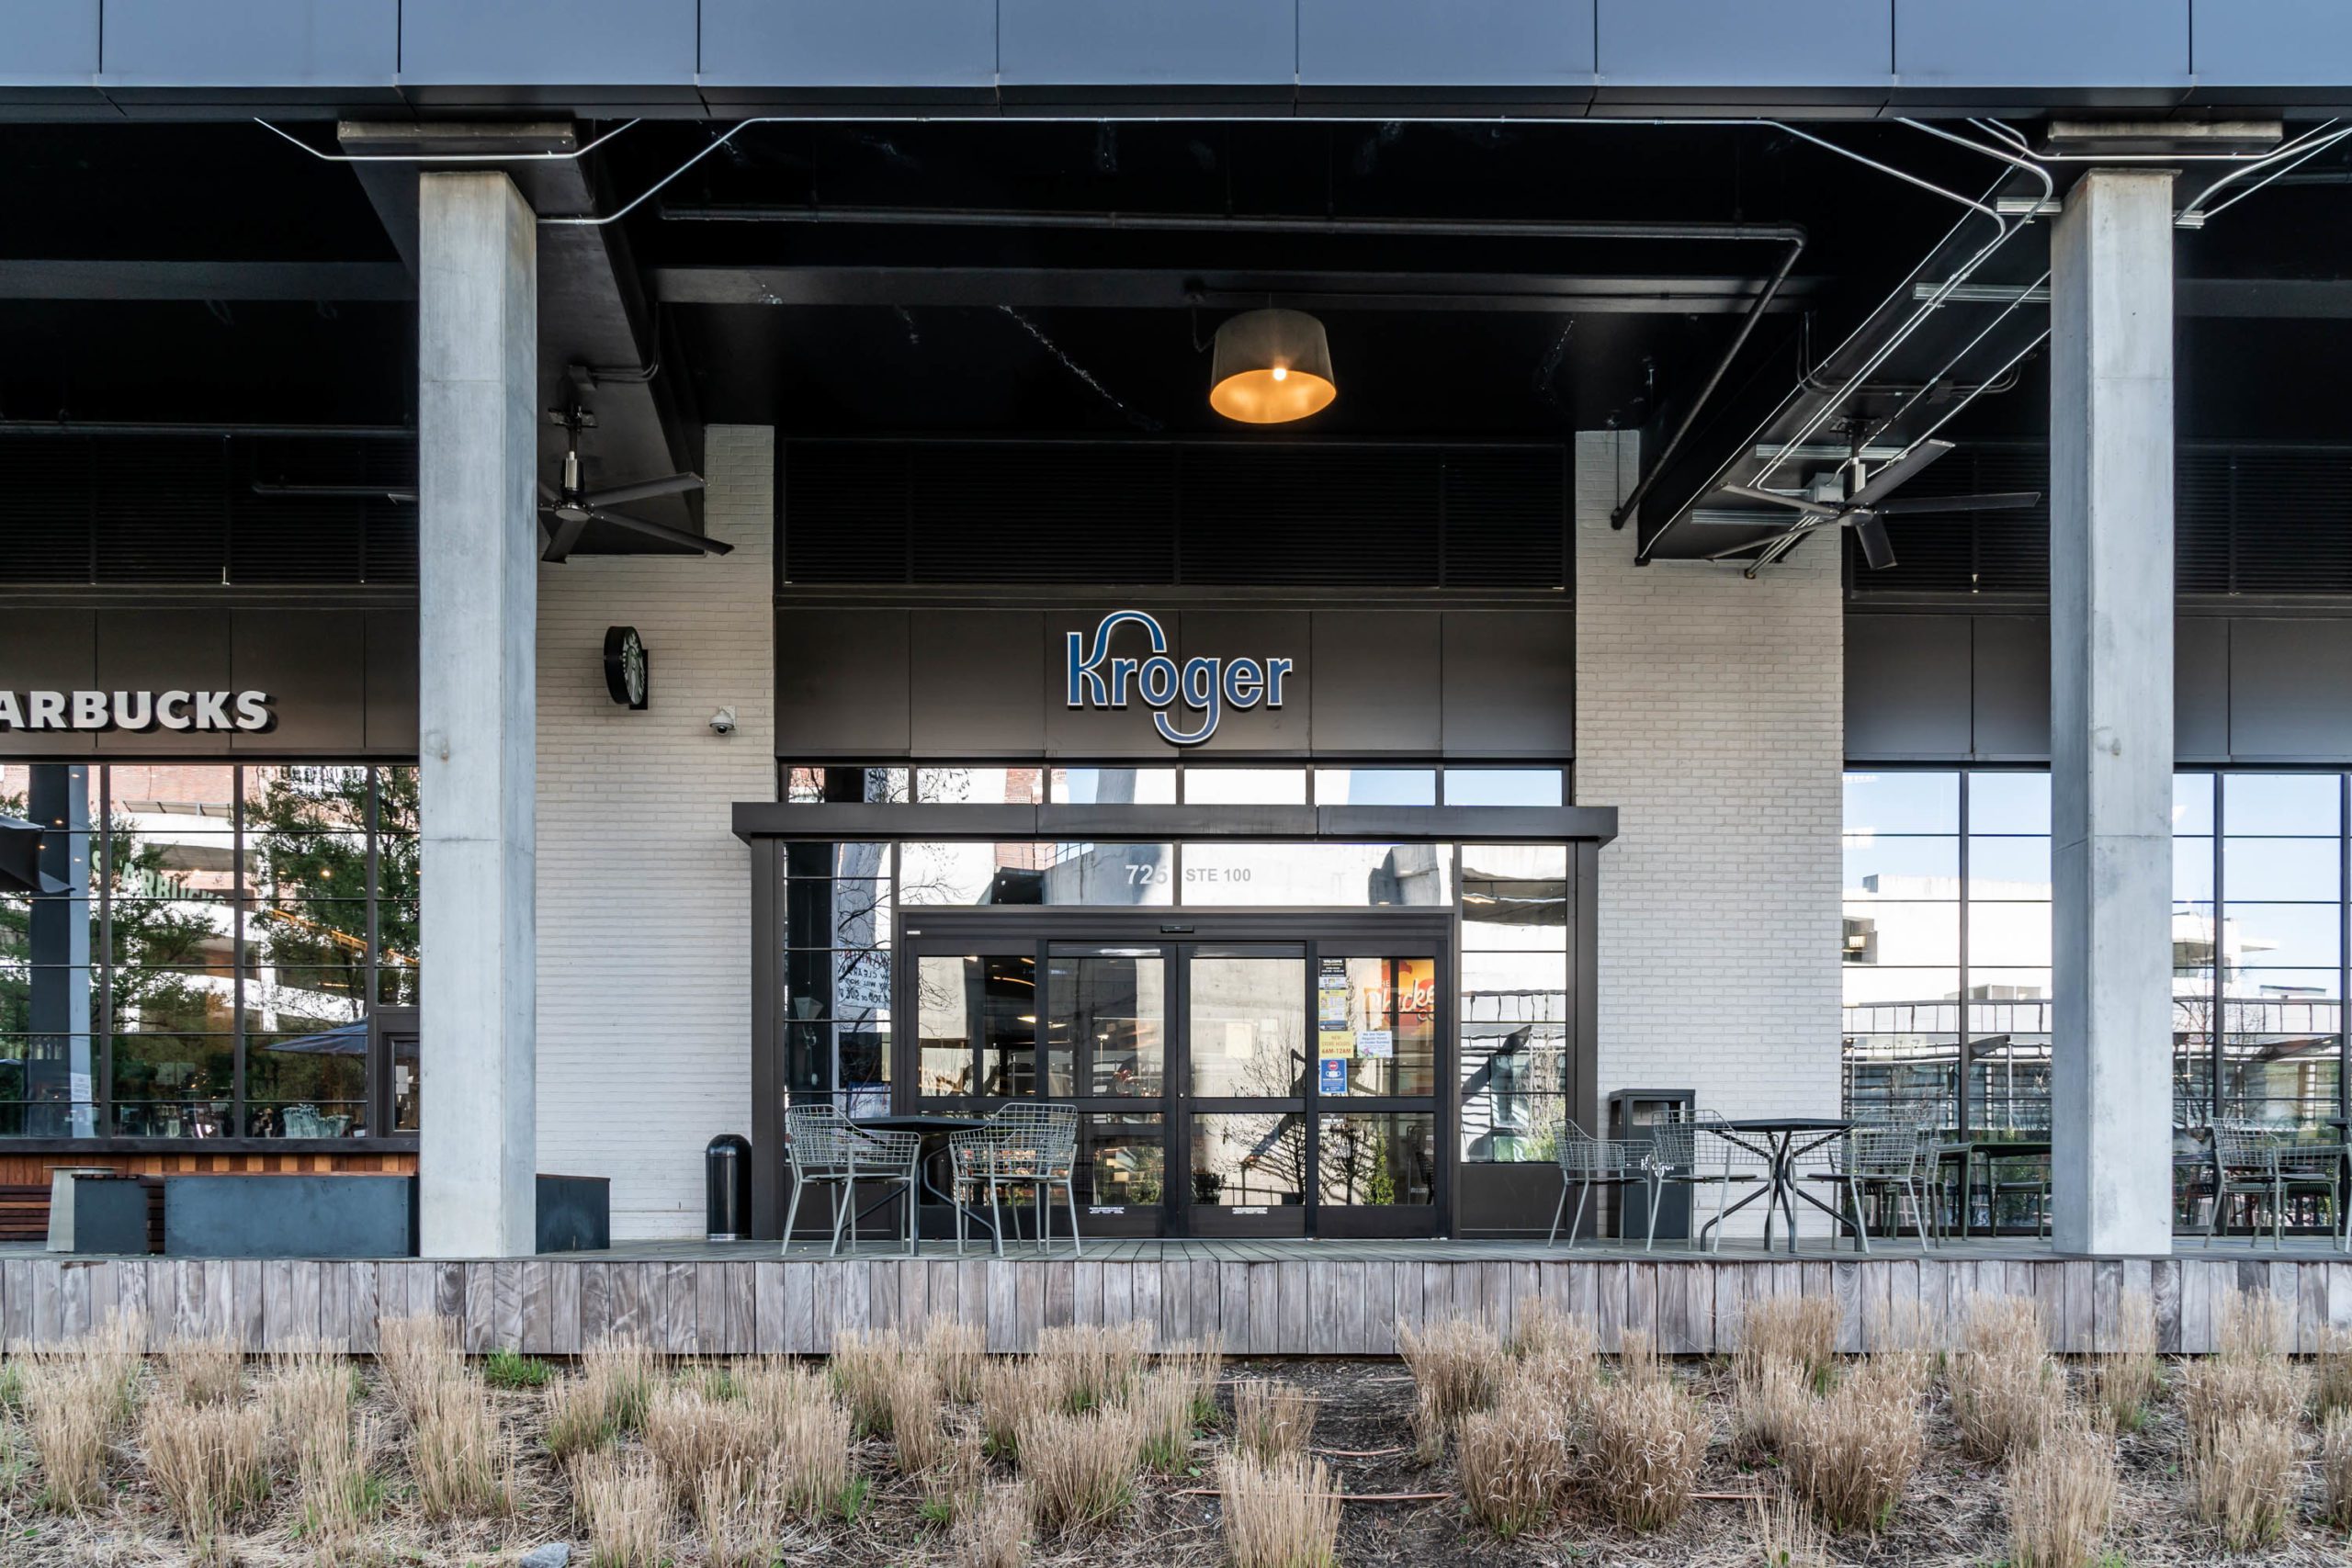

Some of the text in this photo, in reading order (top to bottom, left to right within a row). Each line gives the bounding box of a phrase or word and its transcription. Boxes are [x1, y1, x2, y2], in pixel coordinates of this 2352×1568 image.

[1067, 609, 1293, 744] Kroger
[1125, 864, 1168, 885] 725
[1185, 868, 1251, 882] STE 100
